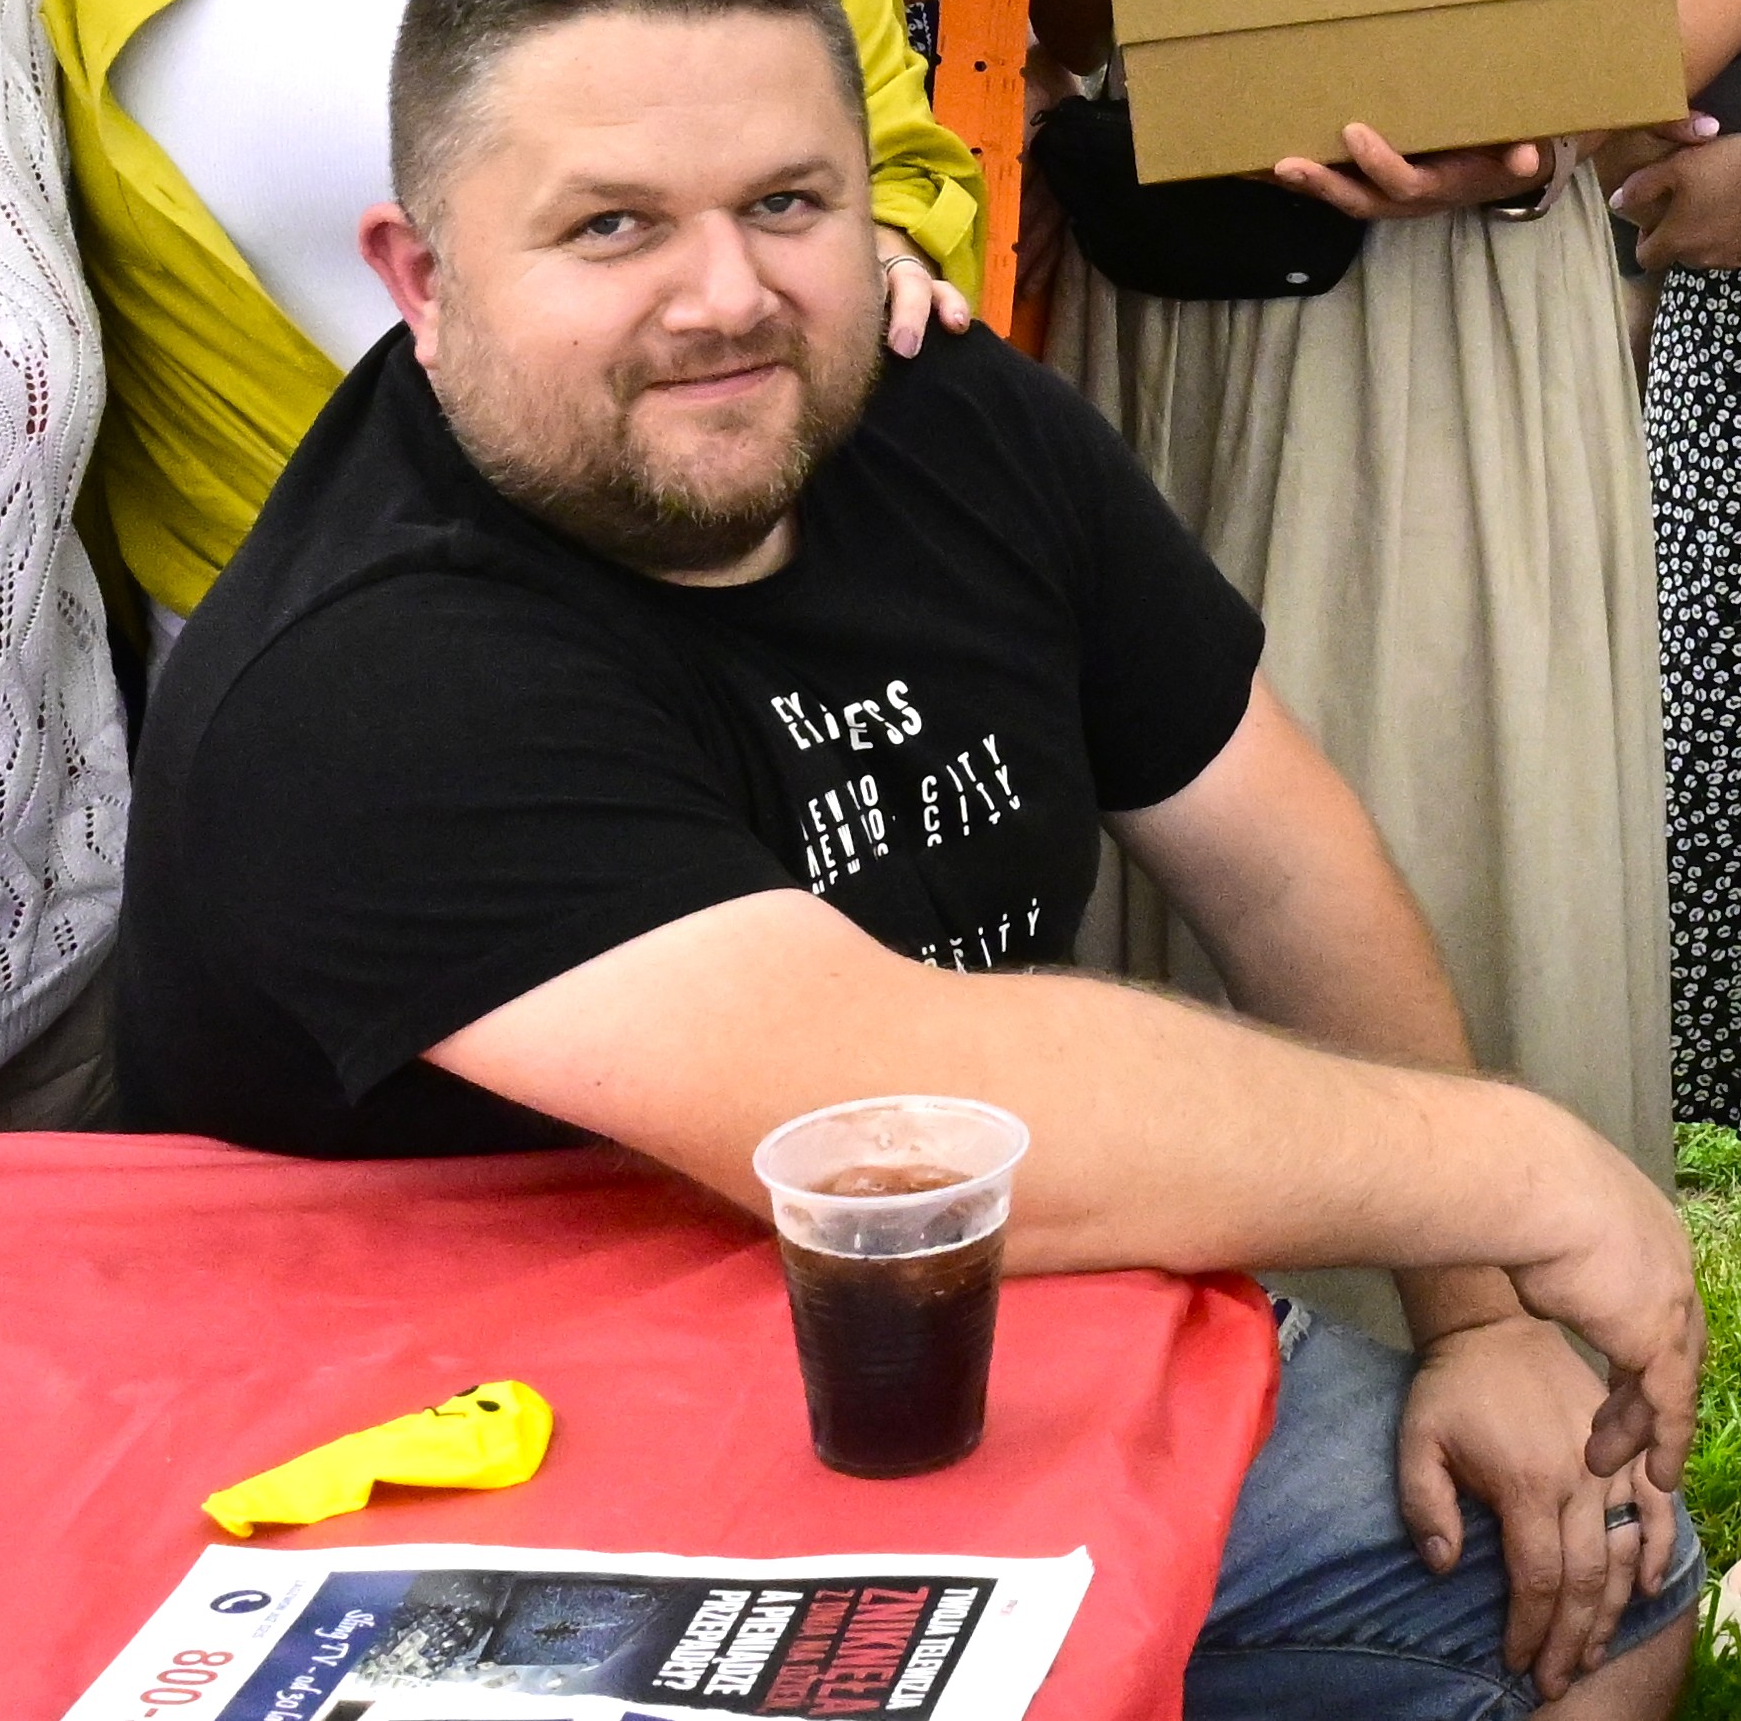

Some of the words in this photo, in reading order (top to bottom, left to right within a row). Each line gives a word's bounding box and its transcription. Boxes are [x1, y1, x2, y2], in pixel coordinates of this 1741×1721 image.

[757, 1589, 804, 1604] A
[315, 1609, 375, 1640] Sling
[926, 1587, 979, 1637] TWOJA
[311, 1642, 350, 1667] TV
[289, 1675, 323, 1695] od
[885, 1636, 956, 1710] TELEWIZJA
[275, 1689, 305, 1709] 30
